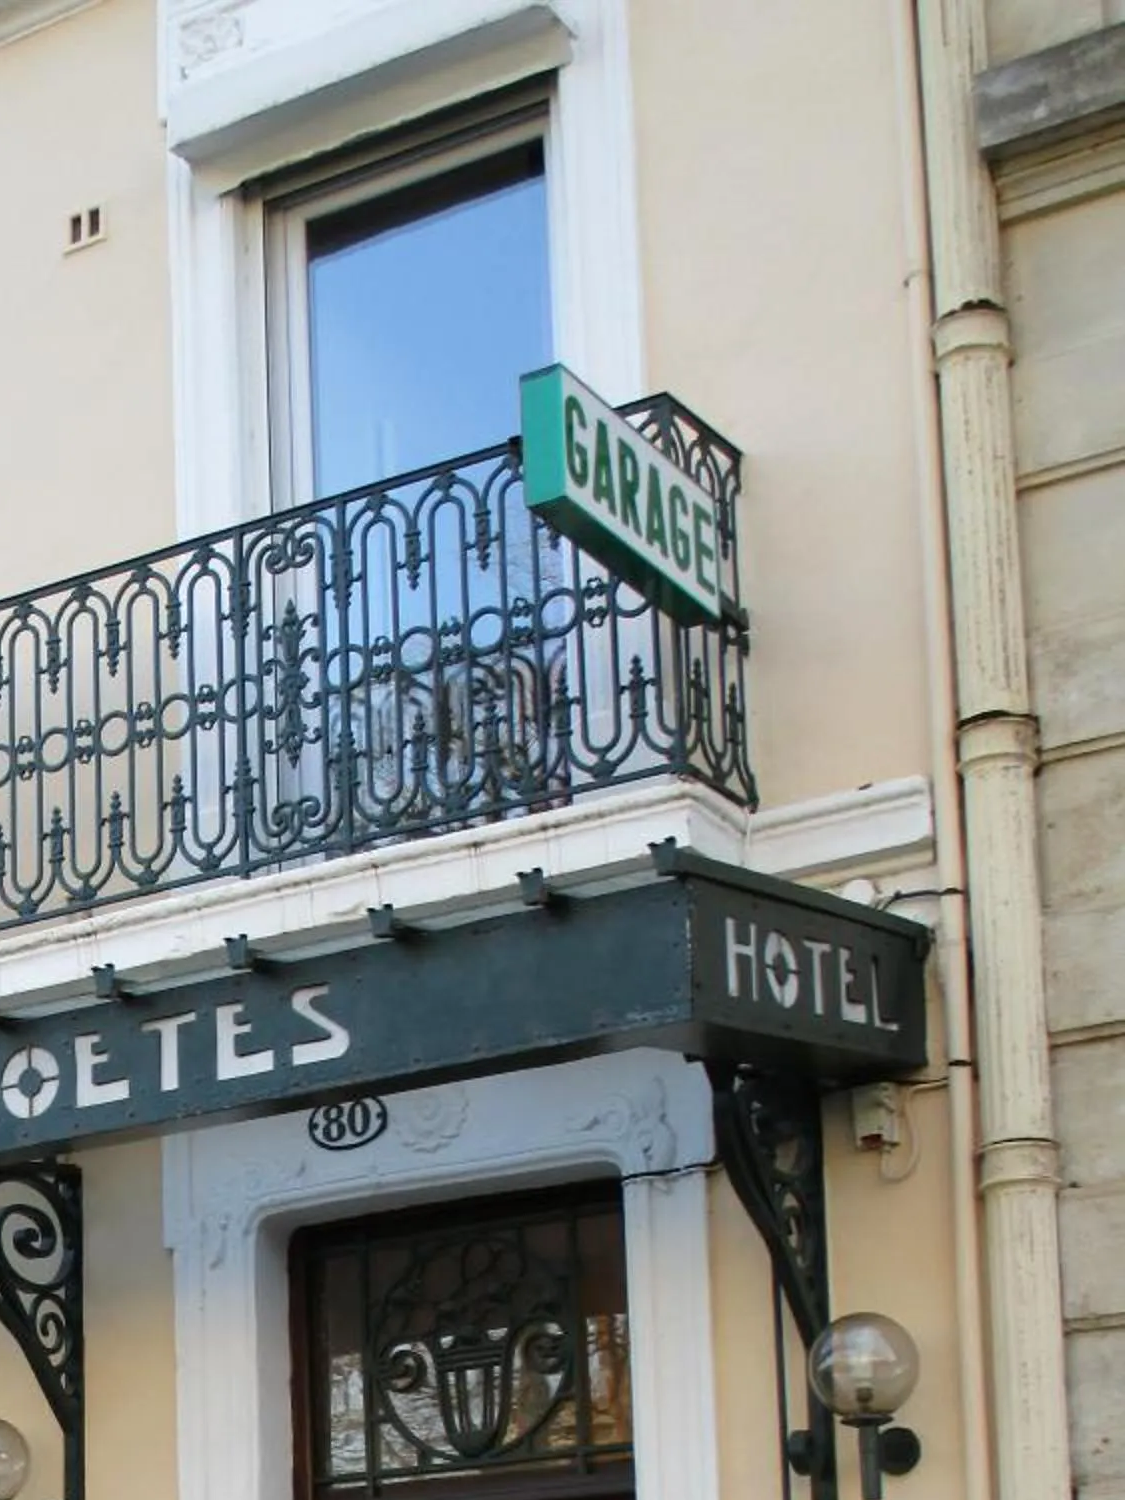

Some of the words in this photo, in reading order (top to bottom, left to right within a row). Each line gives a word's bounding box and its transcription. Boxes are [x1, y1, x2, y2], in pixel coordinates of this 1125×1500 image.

[565, 395, 716, 596] GARAGE
[724, 917, 900, 1031] HOTEL
[322, 1102, 371, 1142] 80
